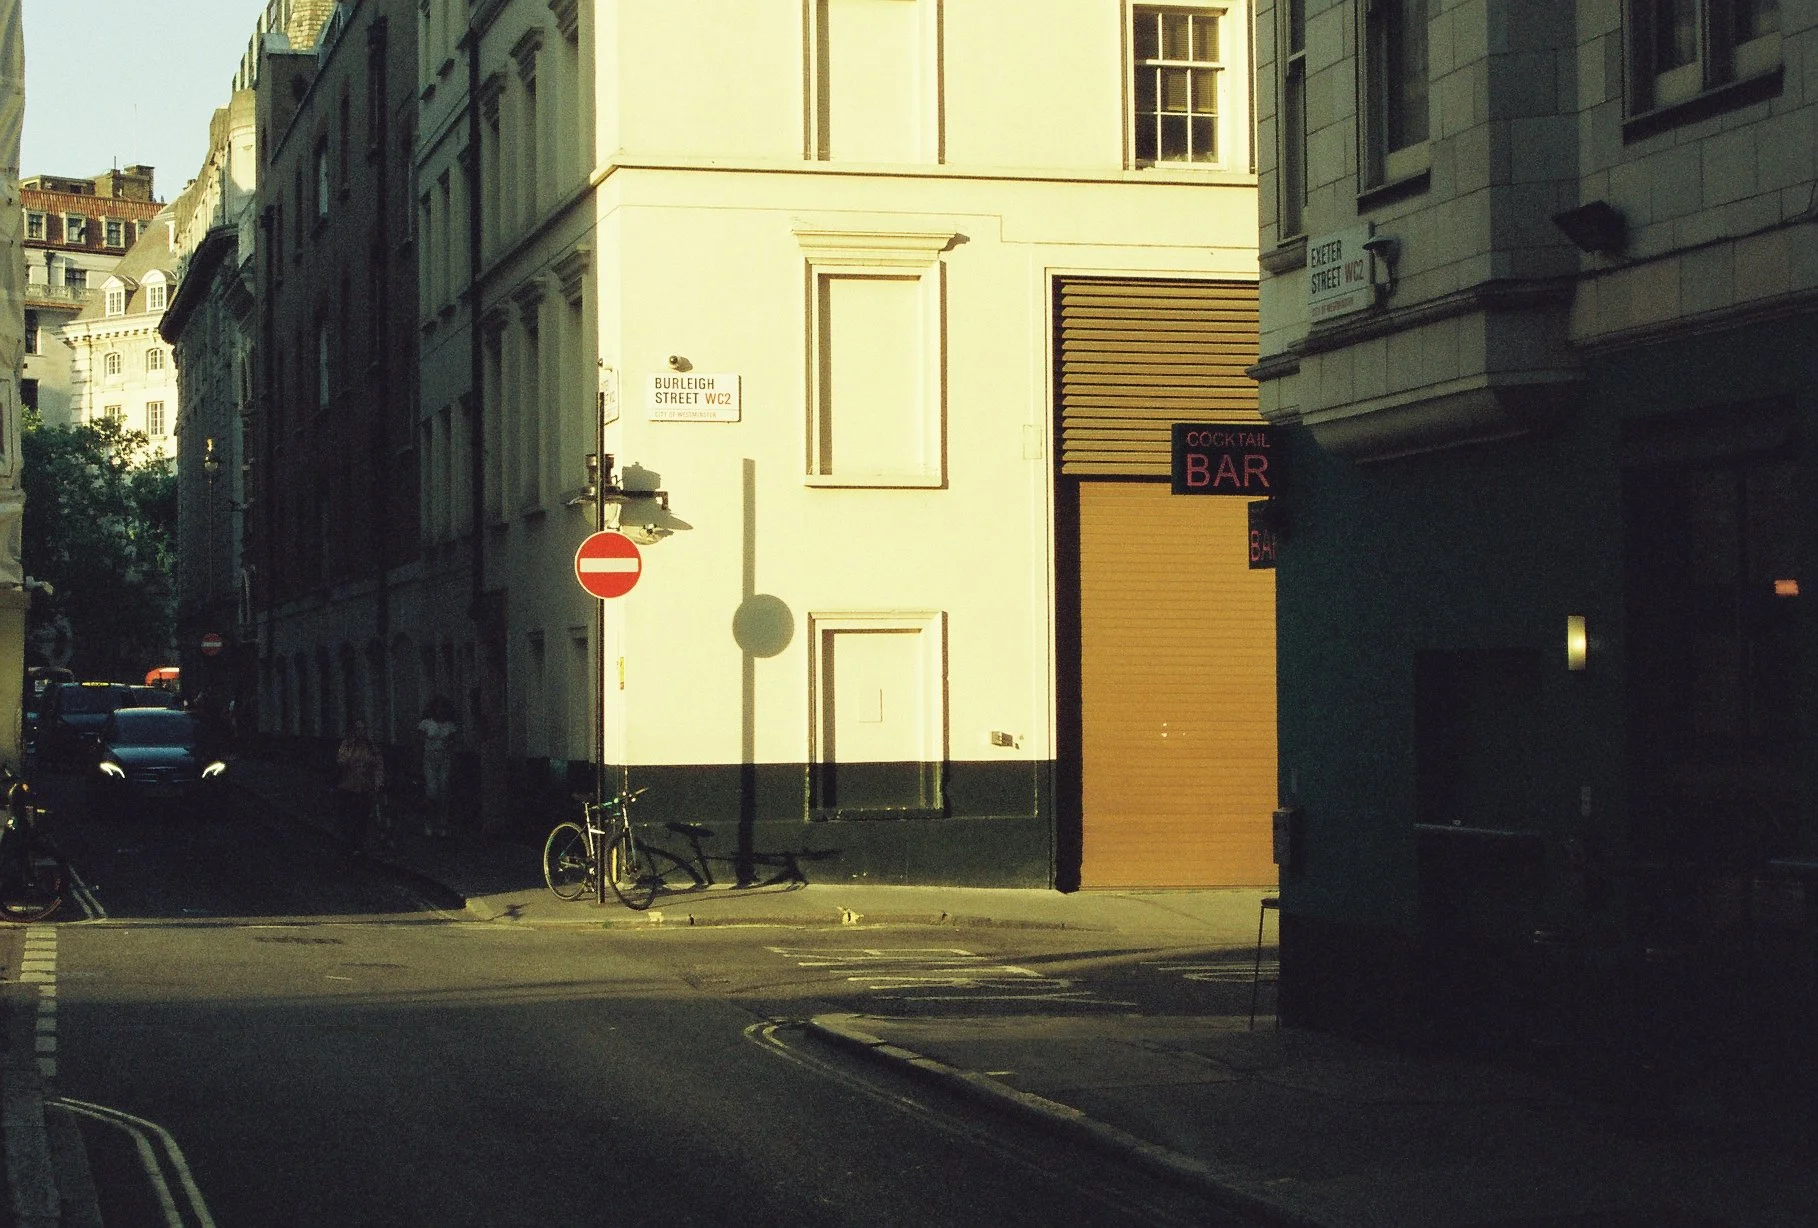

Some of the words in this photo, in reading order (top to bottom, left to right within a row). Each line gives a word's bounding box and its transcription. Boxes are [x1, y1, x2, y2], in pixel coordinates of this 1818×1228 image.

[1311, 240, 1342, 268] EXETER
[1311, 265, 1342, 294] STREET
[1344, 259, 1364, 283] WC2
[655, 377, 715, 390] BURLEIGH
[655, 391, 700, 404] STREET
[705, 392, 732, 405] WC2
[1187, 431, 1271, 448] COCKTAIL
[1187, 453, 1270, 487] BAR
